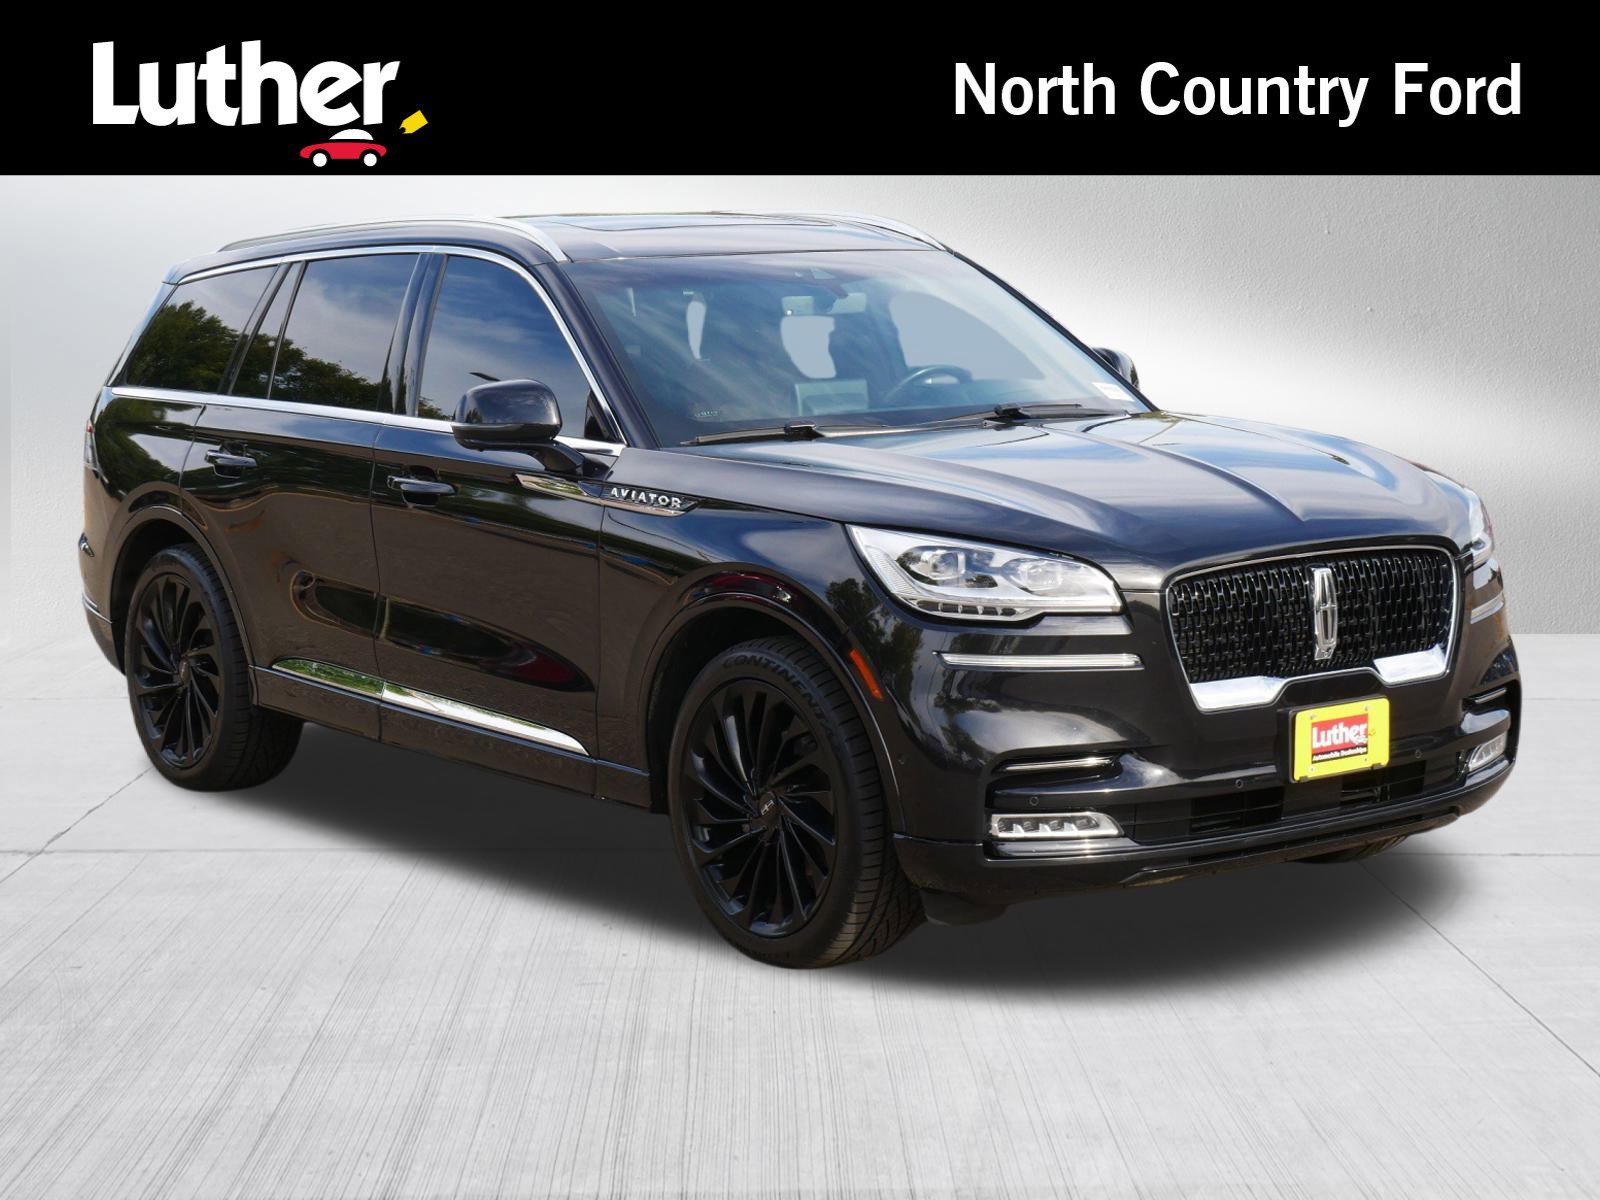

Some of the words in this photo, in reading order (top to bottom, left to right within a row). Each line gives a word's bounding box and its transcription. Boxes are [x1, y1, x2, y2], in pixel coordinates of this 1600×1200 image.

[610, 487, 682, 509] AVIATOR
[722, 655, 840, 751] CONTINENTA
[1312, 721, 1368, 749] Luther
